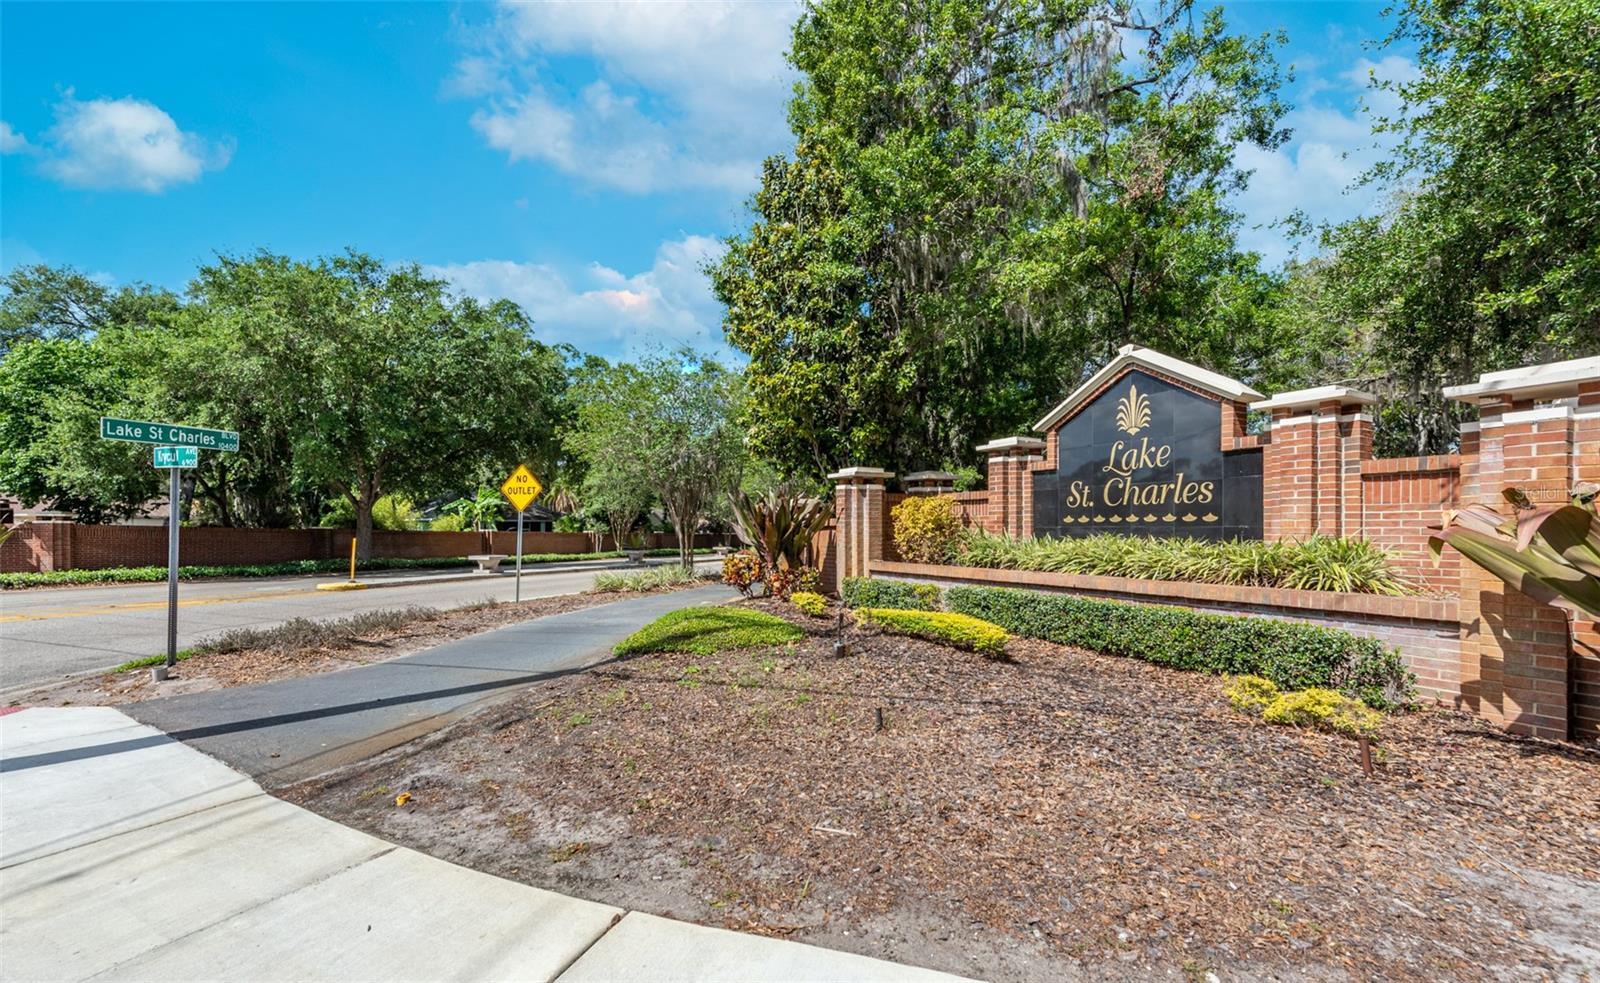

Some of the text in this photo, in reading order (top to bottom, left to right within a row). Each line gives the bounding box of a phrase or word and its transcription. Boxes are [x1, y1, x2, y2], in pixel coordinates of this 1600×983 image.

[106, 421, 237, 446] Lake St Charles BLVD
[218, 442, 237, 450] 10400
[185, 447, 196, 455] AVE
[1102, 437, 1171, 476] Lake
[181, 458, 197, 466] 6900
[516, 475, 528, 483] NO
[507, 486, 536, 495] OUTLET
[1066, 473, 1214, 508] St. Charles
